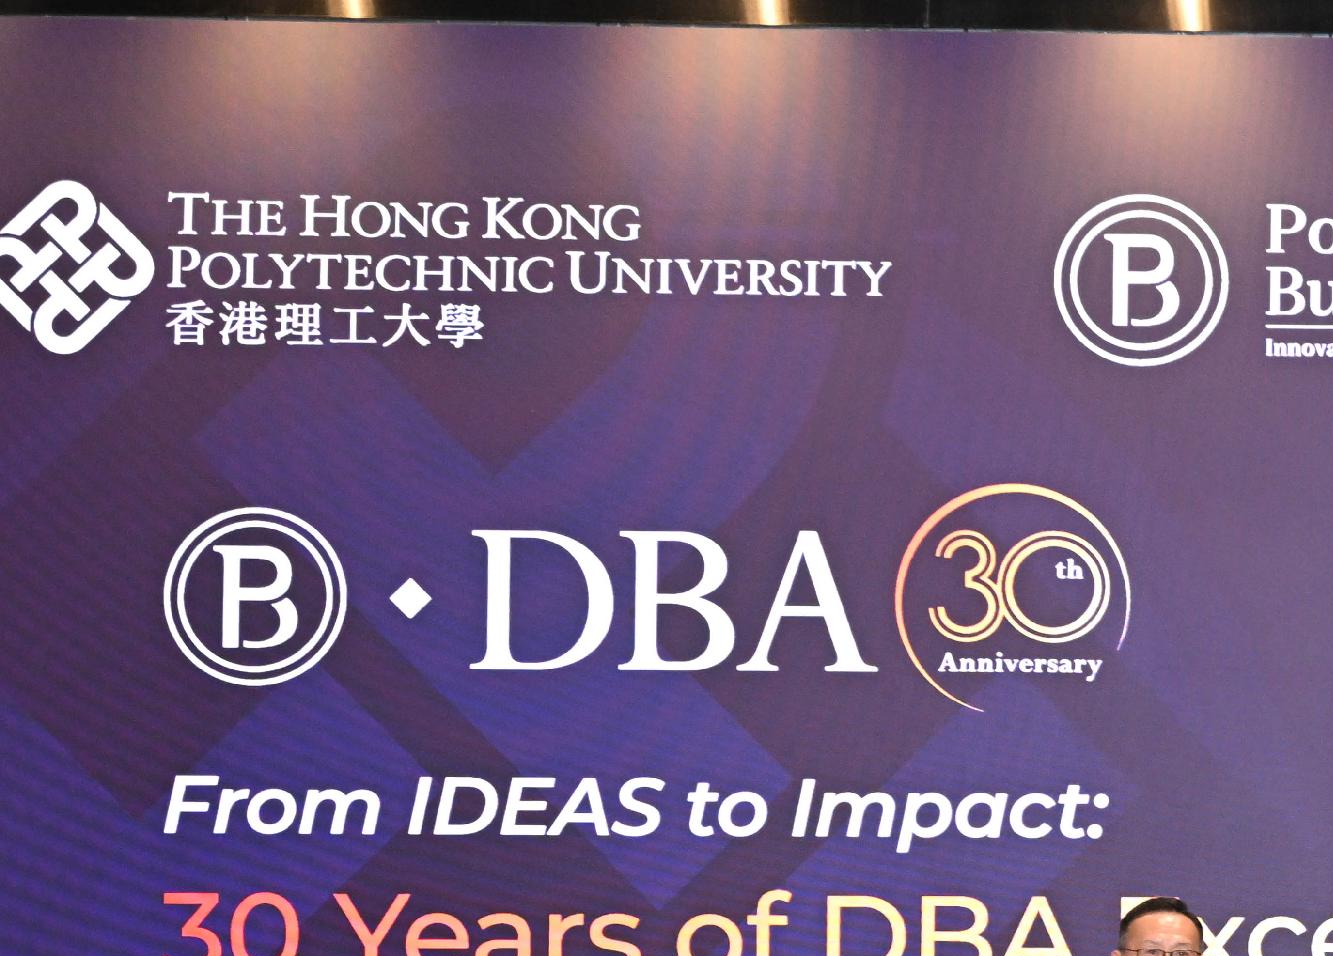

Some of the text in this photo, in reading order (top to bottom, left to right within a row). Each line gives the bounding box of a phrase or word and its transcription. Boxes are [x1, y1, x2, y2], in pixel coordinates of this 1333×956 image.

[167, 191, 642, 242] THE HONG KONG
[166, 246, 892, 297] POLYTECHNIC UNIVERSITY
[165, 299, 485, 348] 香港理工大學
[469, 529, 879, 673] DBA
[937, 652, 1104, 684] Anniversary
[163, 775, 1110, 854] From IDEAS to Impact:
